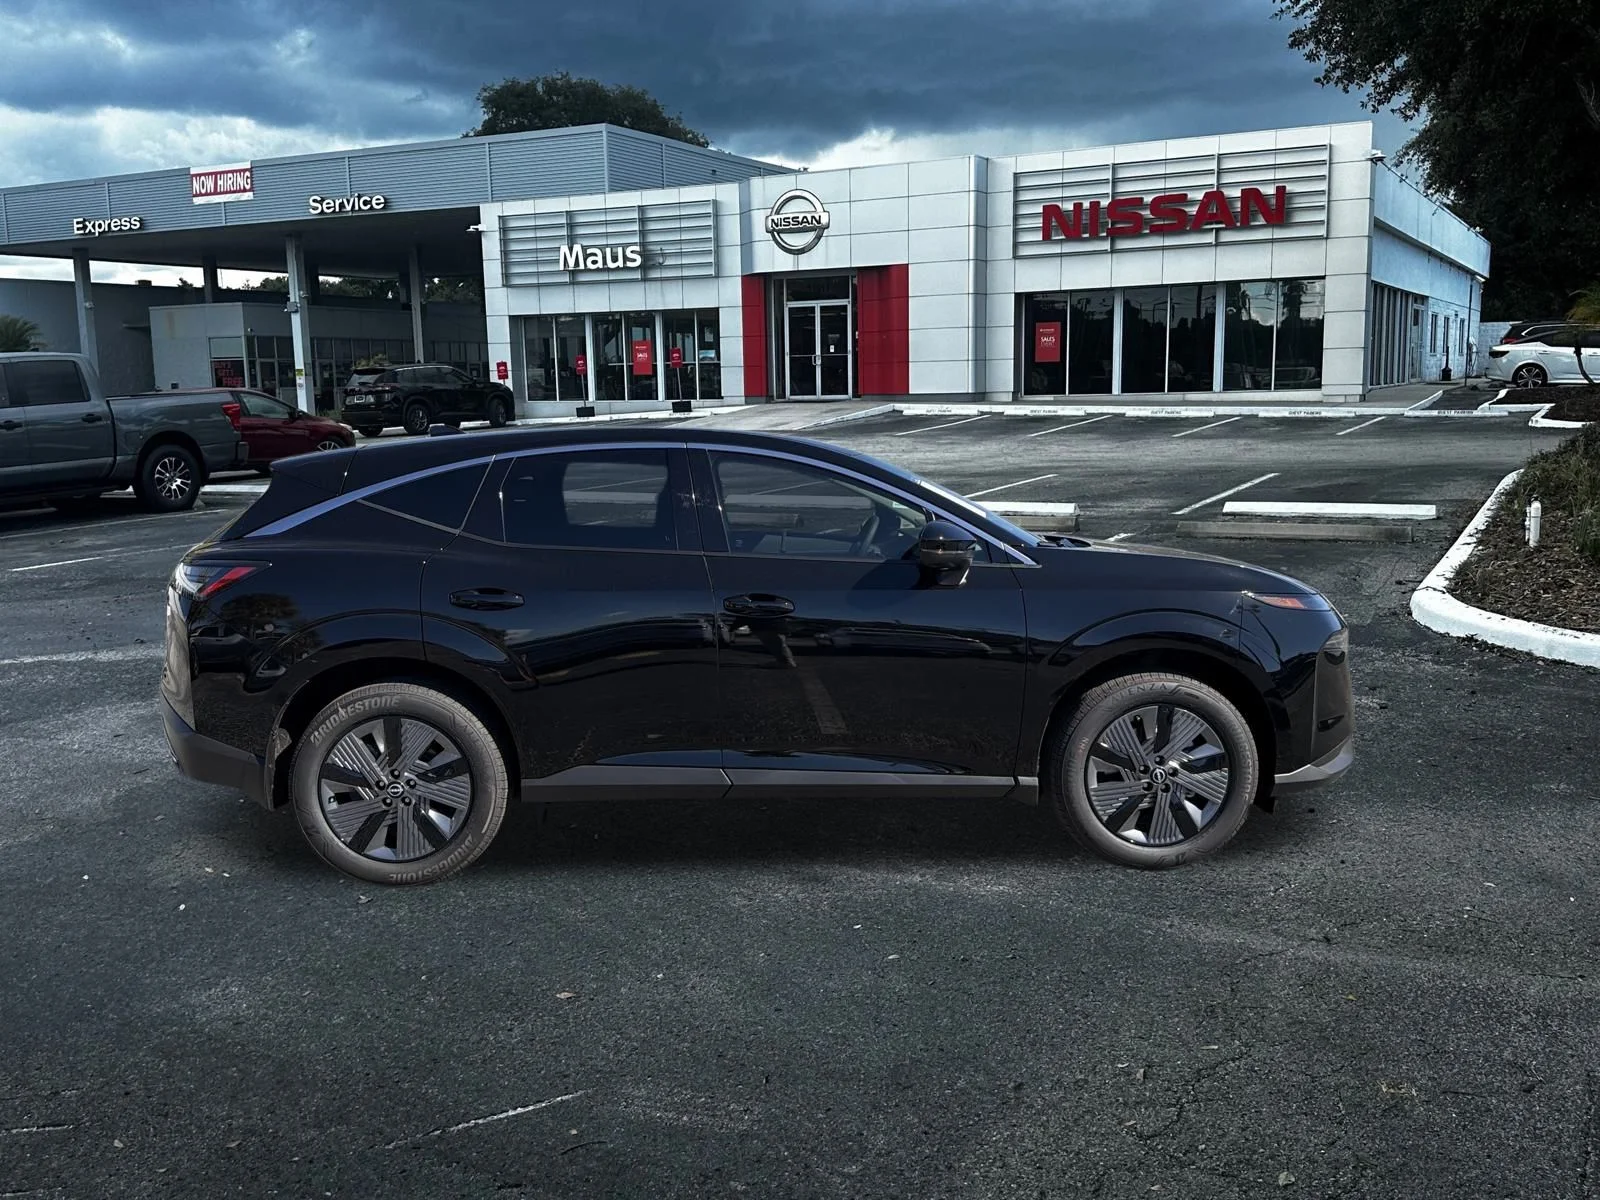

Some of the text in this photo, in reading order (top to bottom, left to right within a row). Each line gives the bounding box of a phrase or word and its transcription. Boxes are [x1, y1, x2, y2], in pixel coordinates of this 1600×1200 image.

[192, 170, 251, 195] NOW HIRING
[308, 193, 386, 215] Service
[1041, 185, 1287, 241] NISSAN
[73, 215, 140, 237] Express
[770, 214, 822, 230] NISSAN
[559, 244, 642, 271] Maus
[309, 695, 401, 746] BRIDGESTONE
